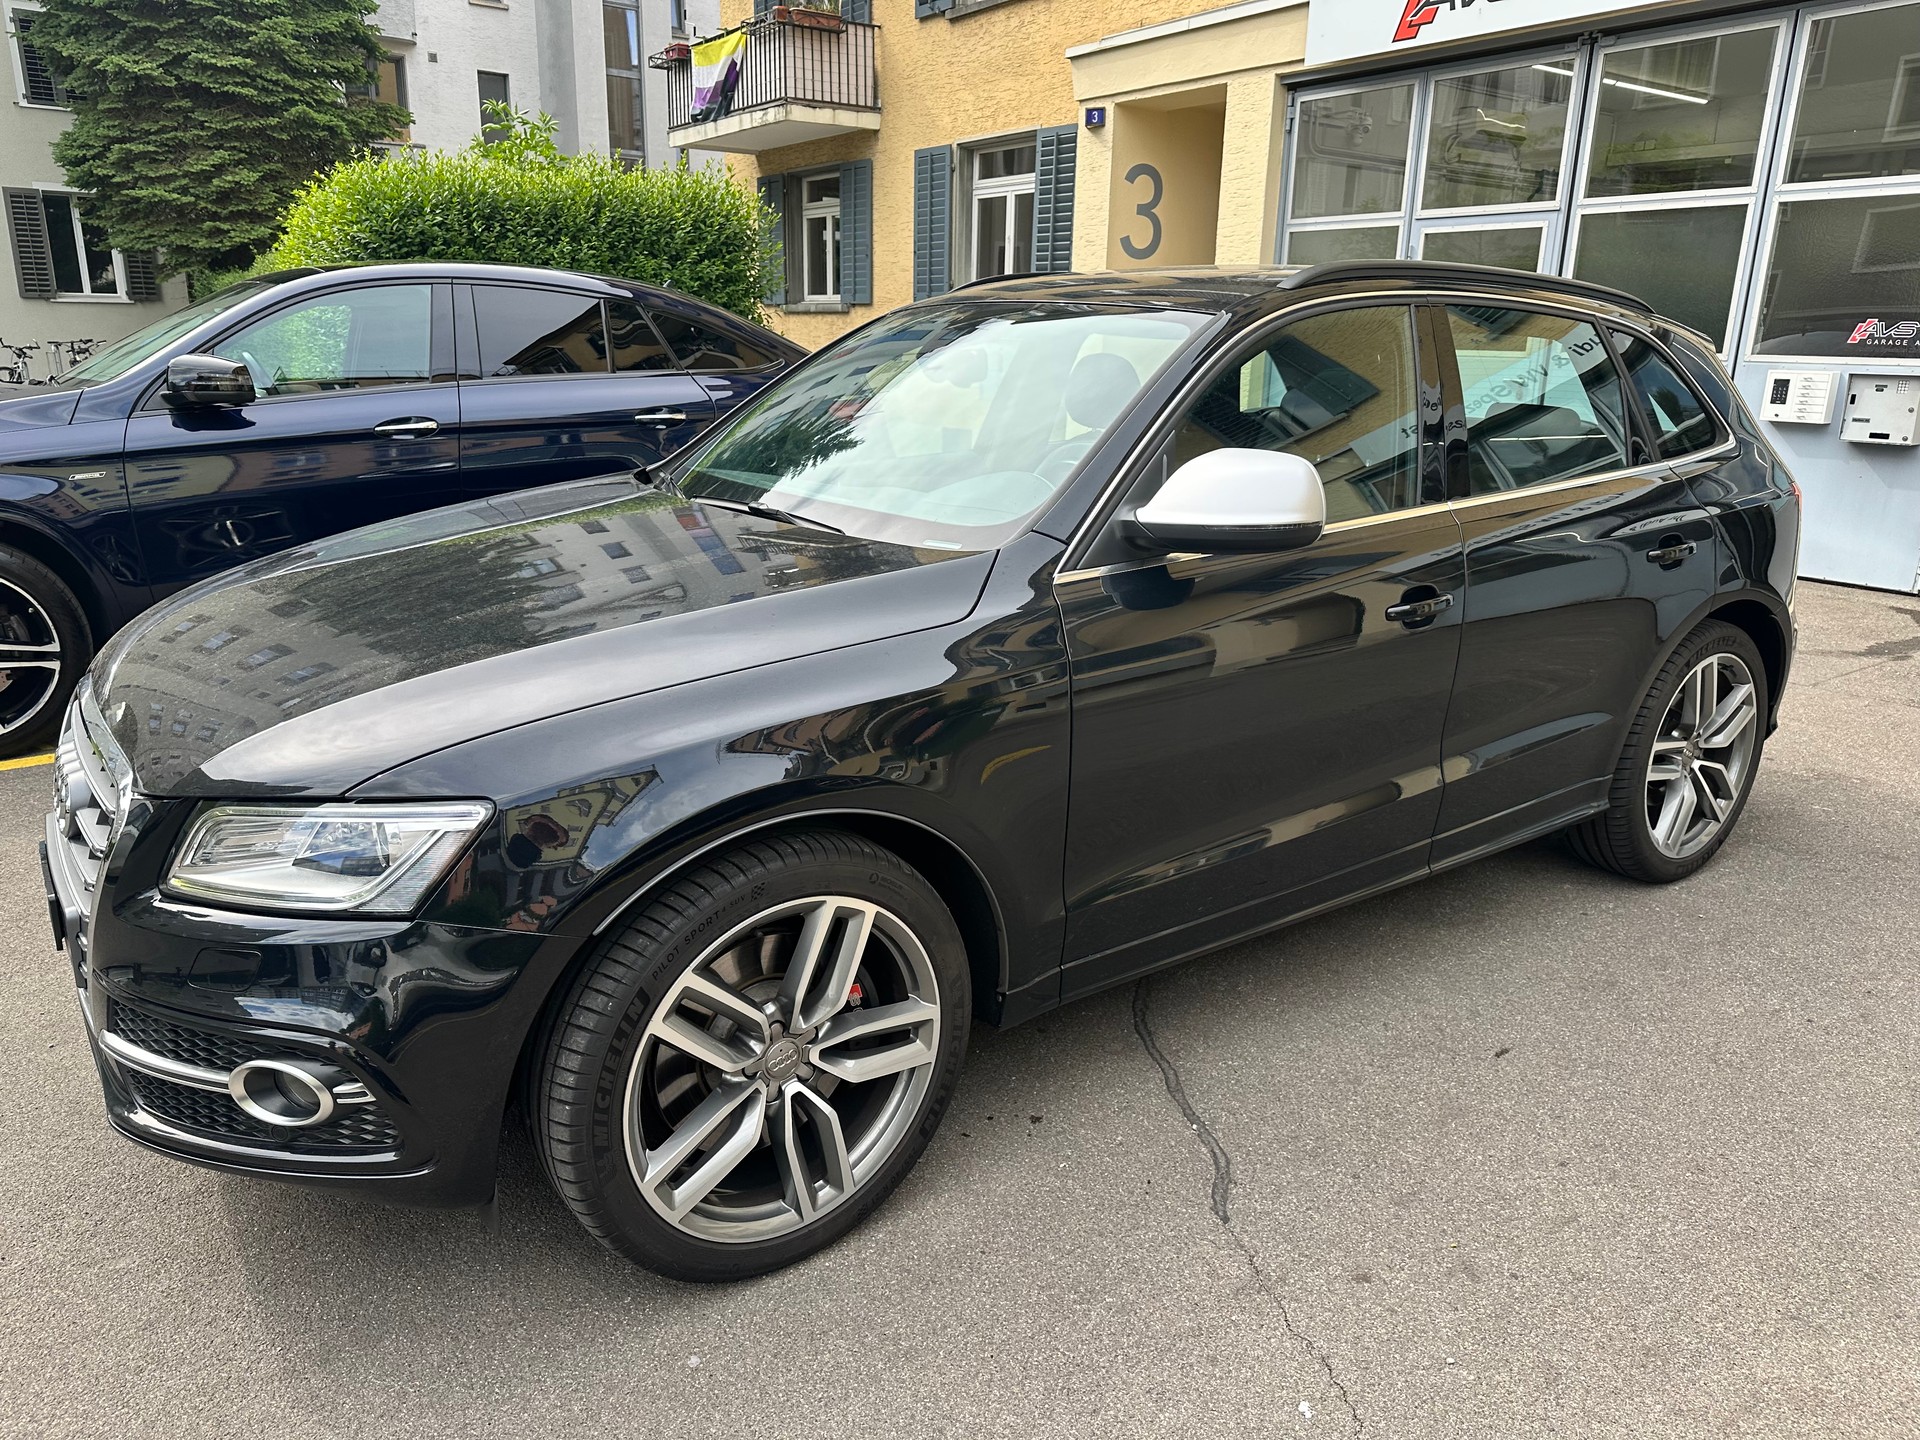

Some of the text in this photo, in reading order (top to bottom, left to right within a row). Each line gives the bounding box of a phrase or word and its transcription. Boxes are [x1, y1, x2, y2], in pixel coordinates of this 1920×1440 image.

[1091, 111, 1099, 123] 3
[1119, 163, 1163, 260] 3
[1853, 320, 1920, 338] AVS
[651, 944, 681, 981] PILOT
[684, 909, 721, 945] SPORT
[729, 894, 747, 908] SUV
[592, 996, 648, 1148] MICHELIN
